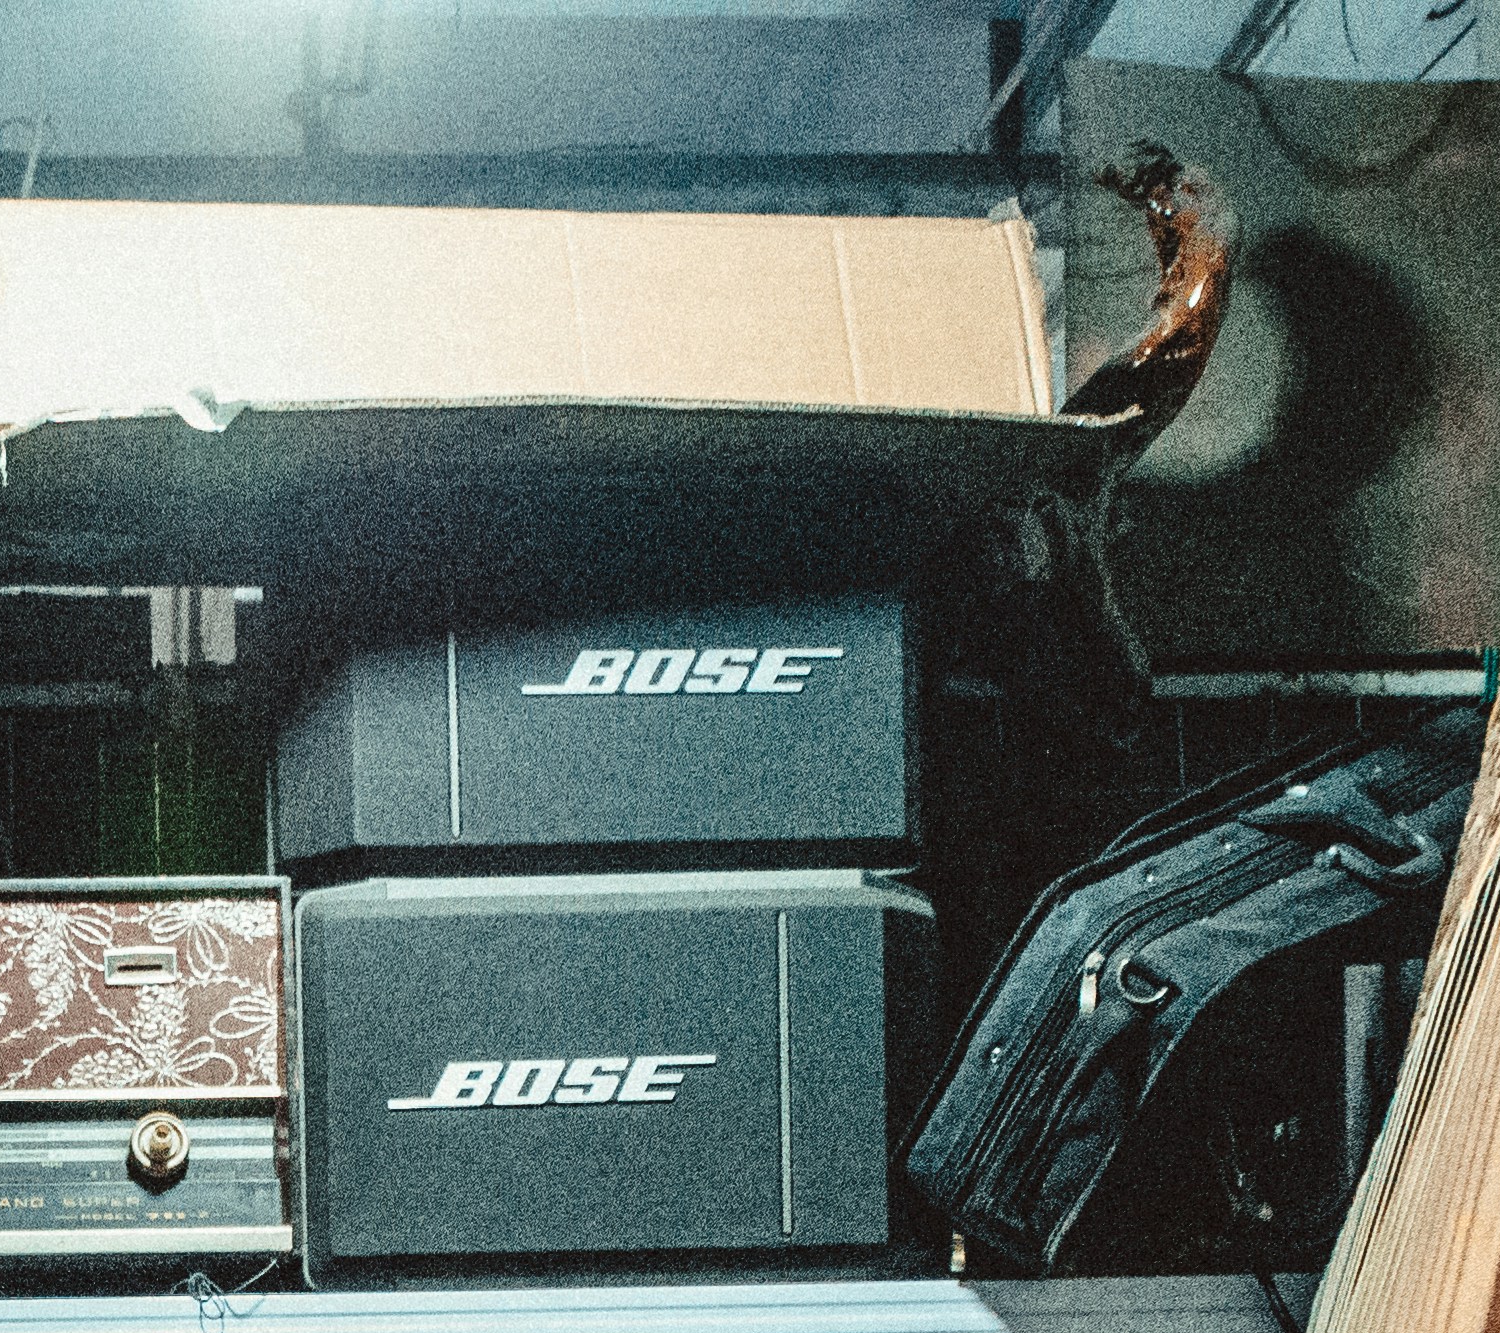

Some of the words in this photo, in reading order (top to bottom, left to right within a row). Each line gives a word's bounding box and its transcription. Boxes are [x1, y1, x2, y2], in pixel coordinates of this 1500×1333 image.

[521, 646, 845, 697] BOSE
[386, 1053, 718, 1111] BOSE
[62, 1195, 141, 1209] SUPER
